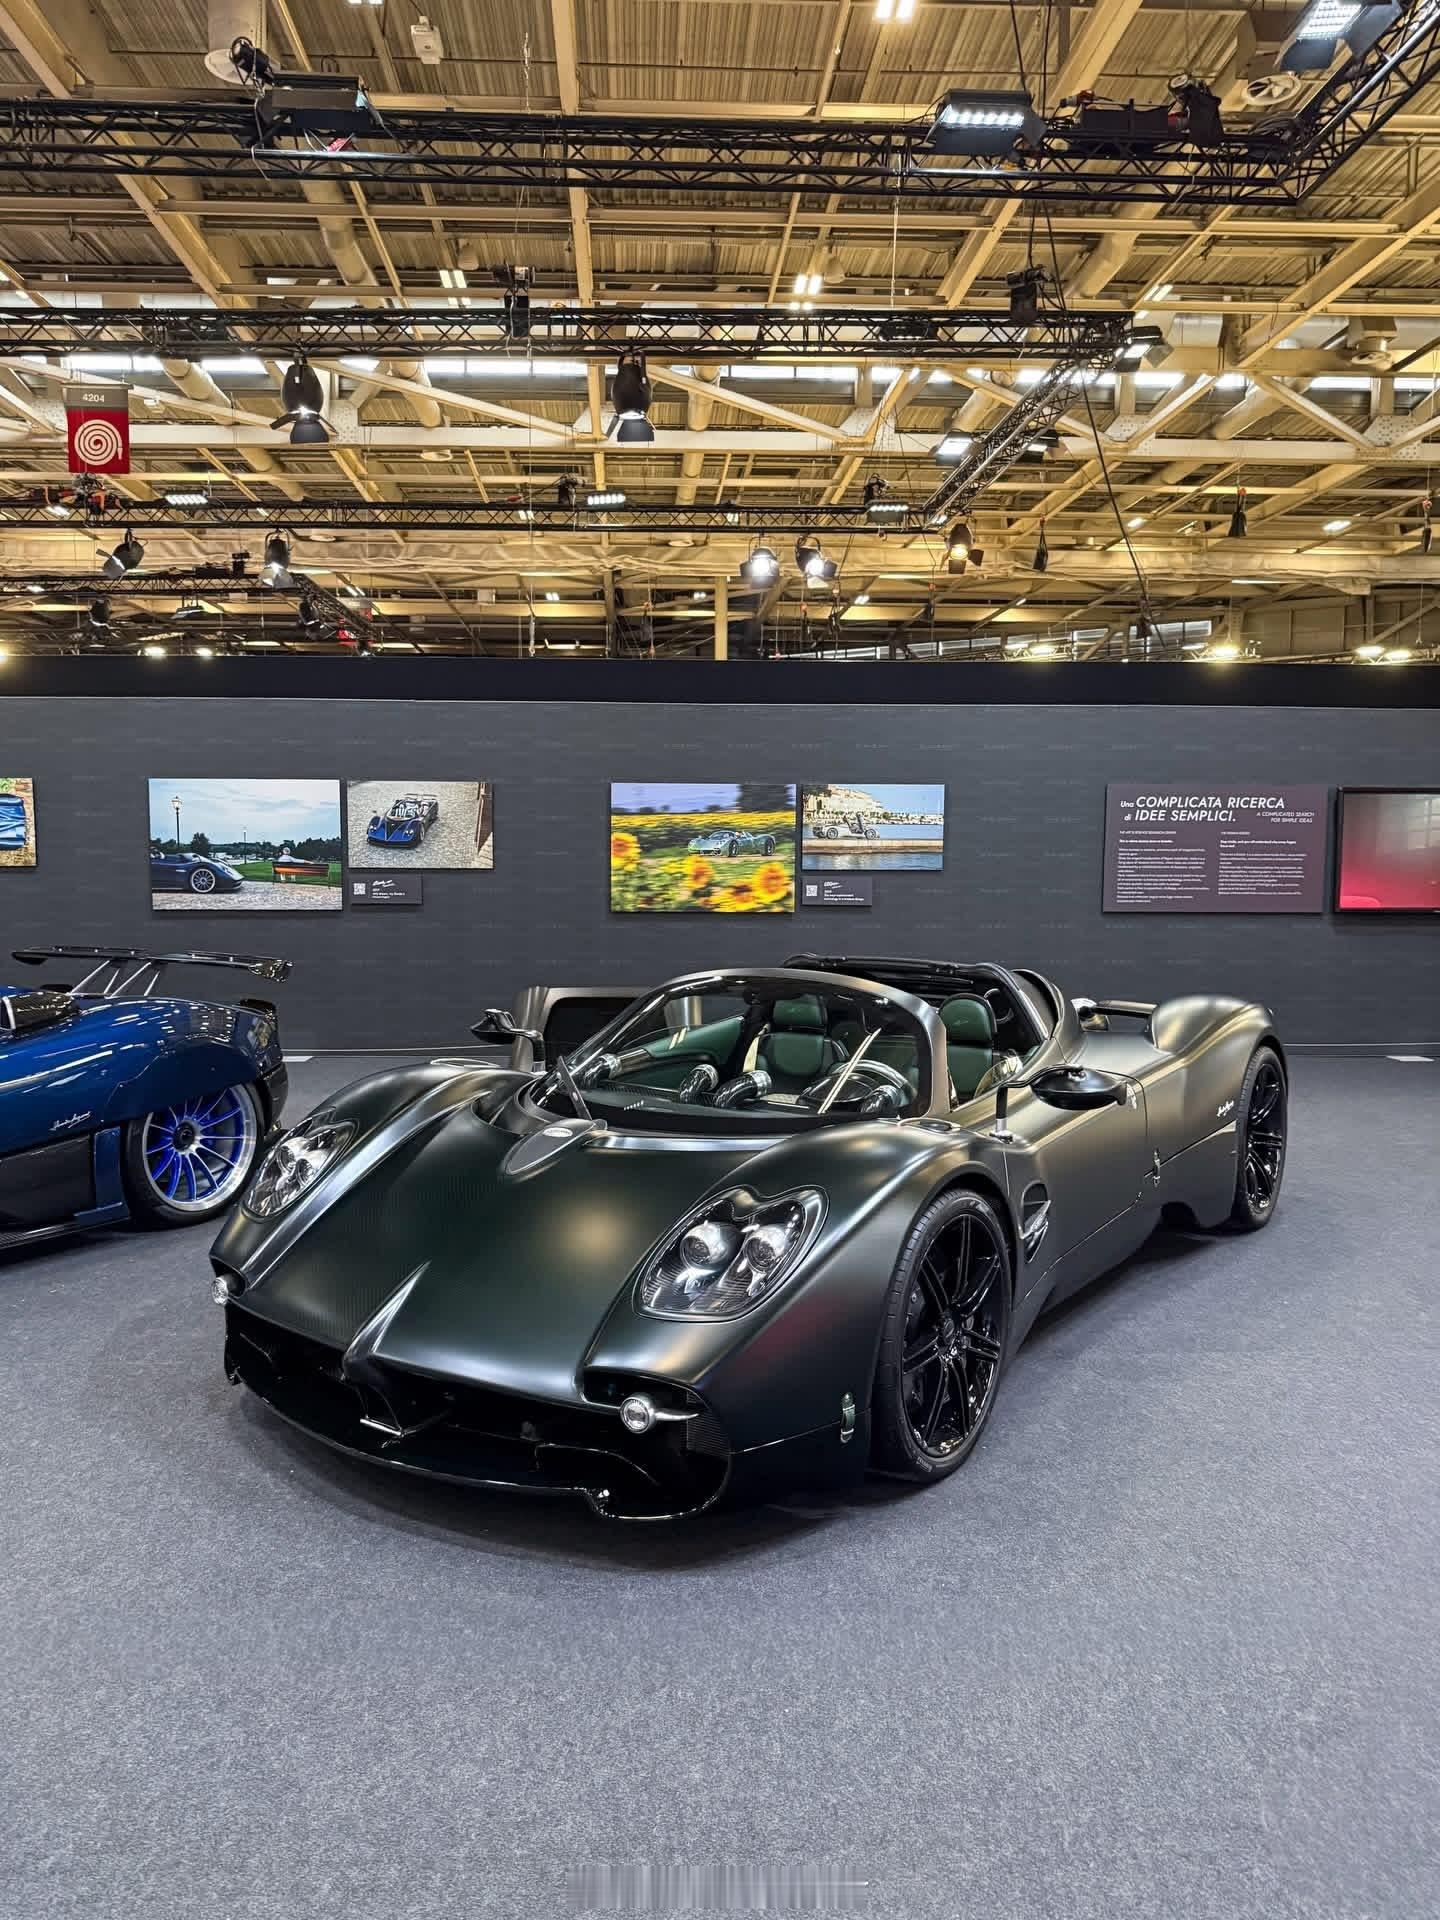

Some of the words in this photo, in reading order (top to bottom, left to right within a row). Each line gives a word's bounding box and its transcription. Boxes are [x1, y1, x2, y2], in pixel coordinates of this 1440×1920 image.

[82, 393, 105, 403] 4204
[1120, 800, 1134, 808] Una
[1136, 796, 1222, 809] COMPLICATA
[1227, 797, 1285, 809] RICERCA
[1124, 813, 1132, 821] di
[1135, 809, 1166, 822] IDEE
[1170, 810, 1236, 822] SEMPLICI.
